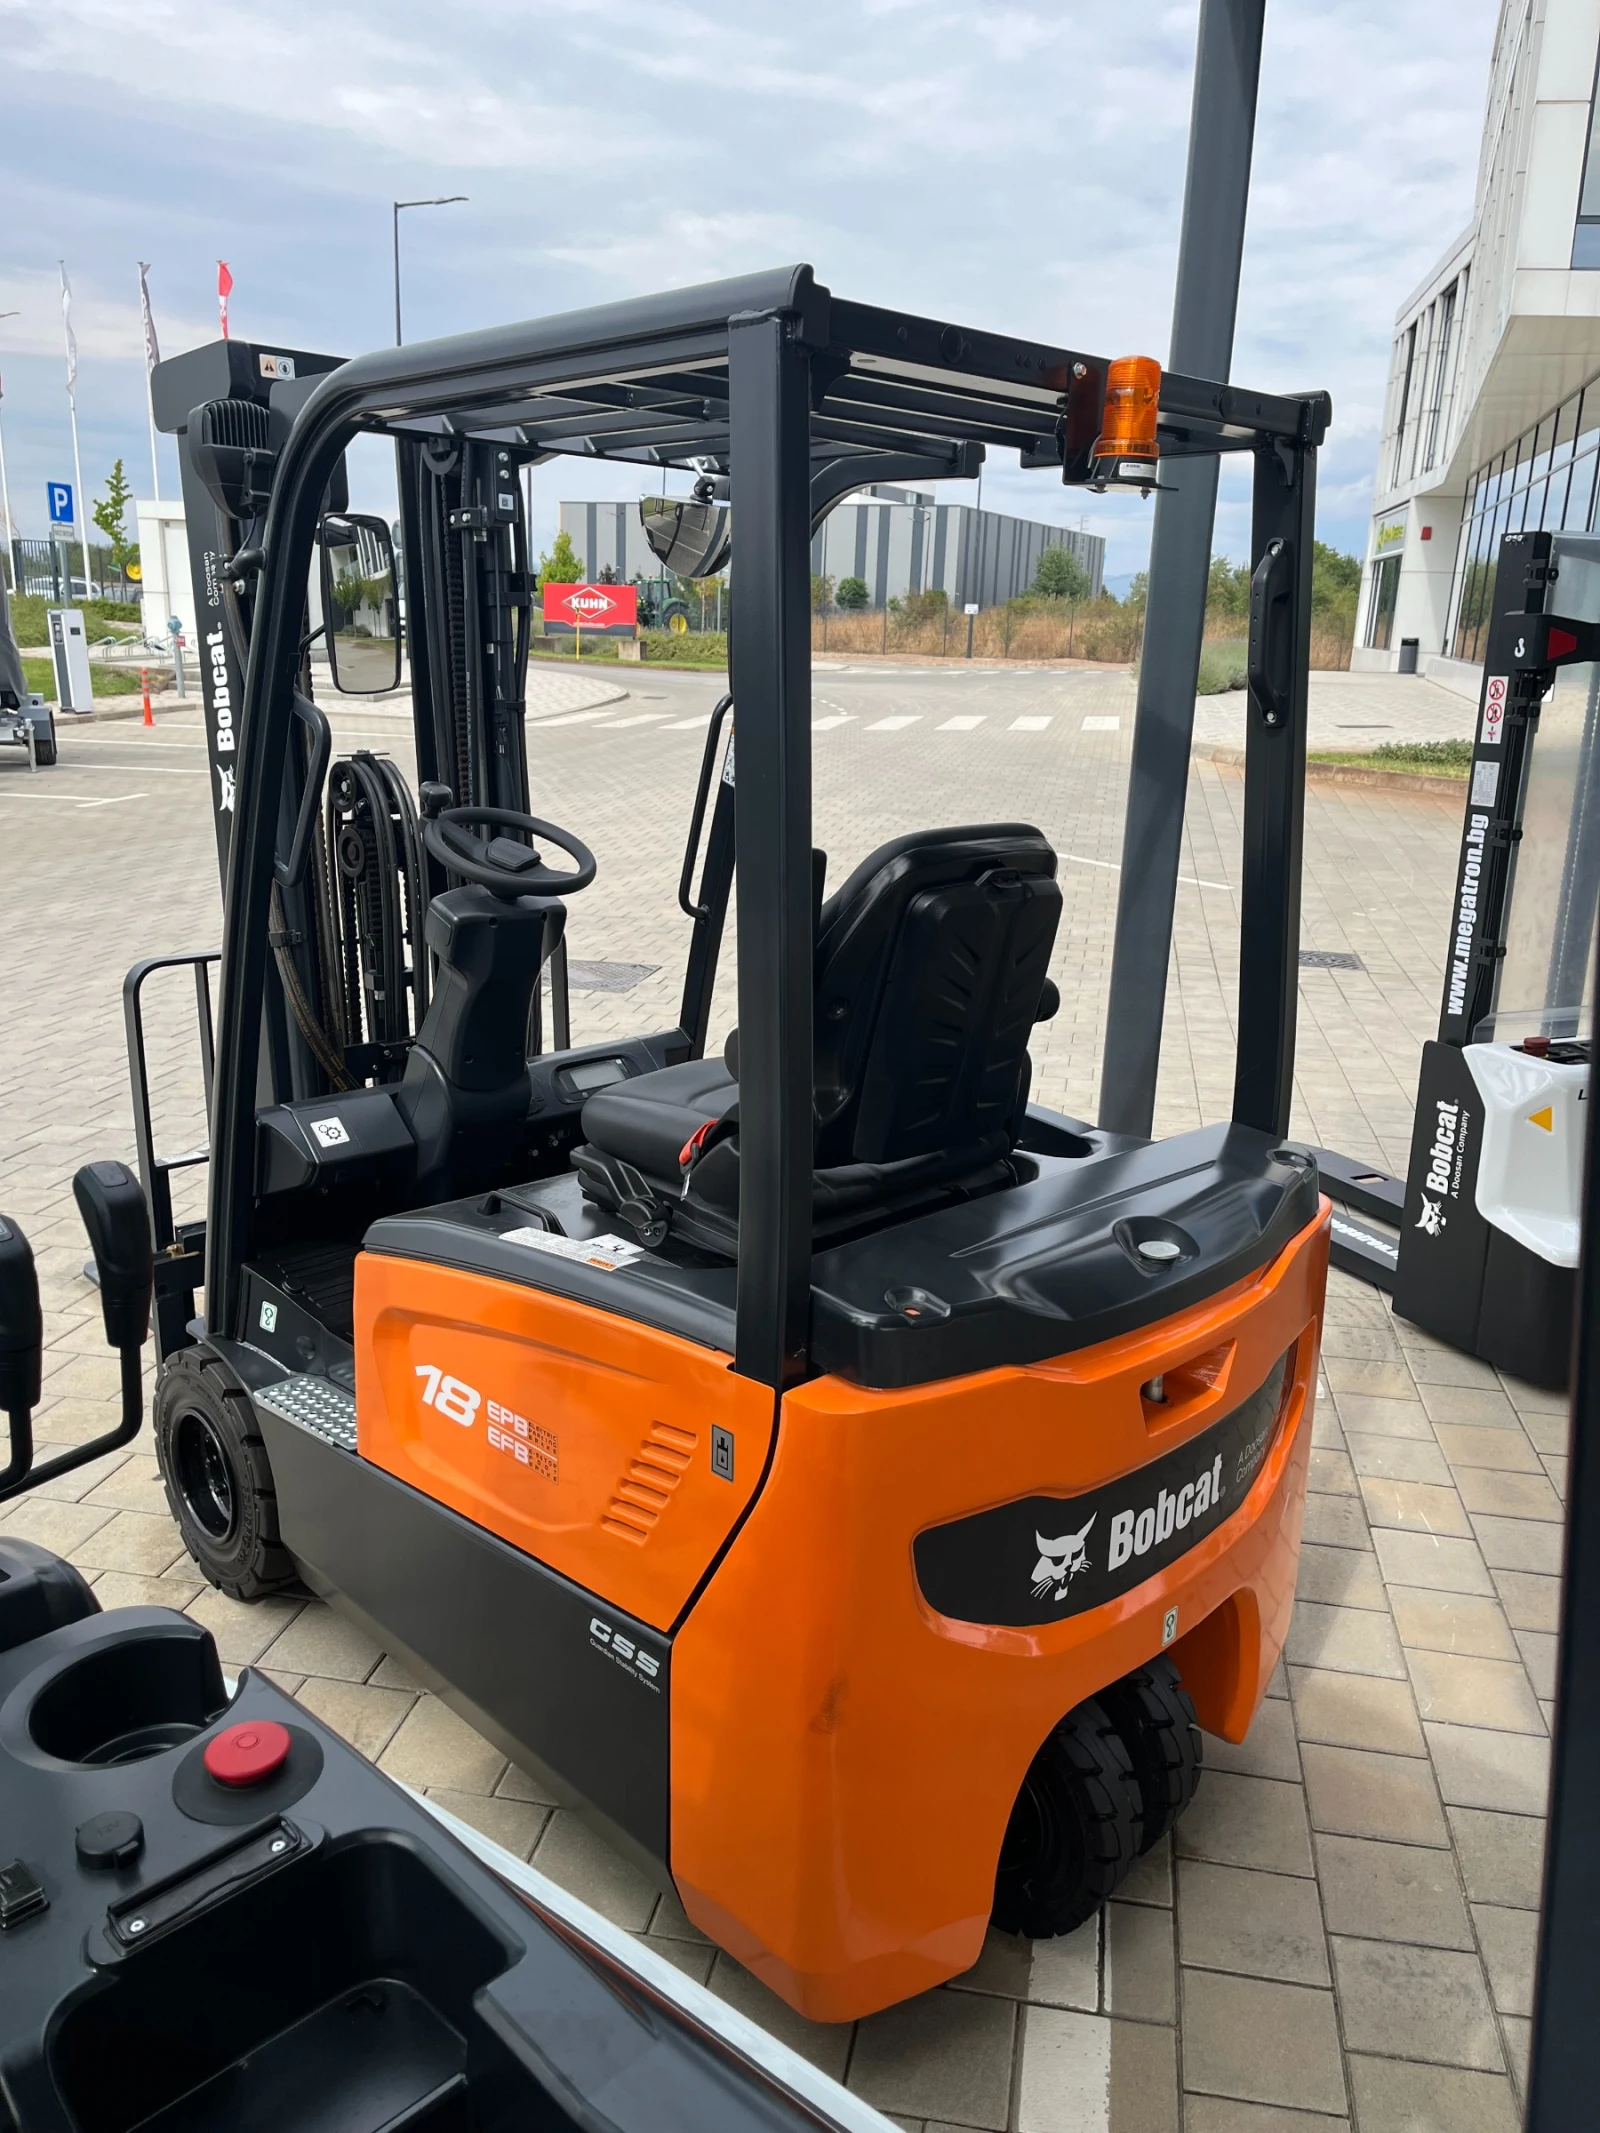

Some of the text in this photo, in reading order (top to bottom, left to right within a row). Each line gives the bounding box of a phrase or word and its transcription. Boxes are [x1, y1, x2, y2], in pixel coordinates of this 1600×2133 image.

[53, 487, 69, 517] P
[203, 552, 213, 596] Doosan
[571, 597, 608, 609] KUHN
[206, 630, 236, 752] Bobcat
[1447, 813, 1490, 1016] www.megatron.bg
[1425, 1100, 1460, 1195] Bobcat
[1450, 1110, 1471, 1199] A Doosan Company
[415, 1364, 482, 1427] 18
[487, 1399, 529, 1437] EPB
[487, 1425, 529, 1464] EFB
[1107, 1453, 1222, 1572] Bobcat
[589, 1617, 660, 1677] GSS
